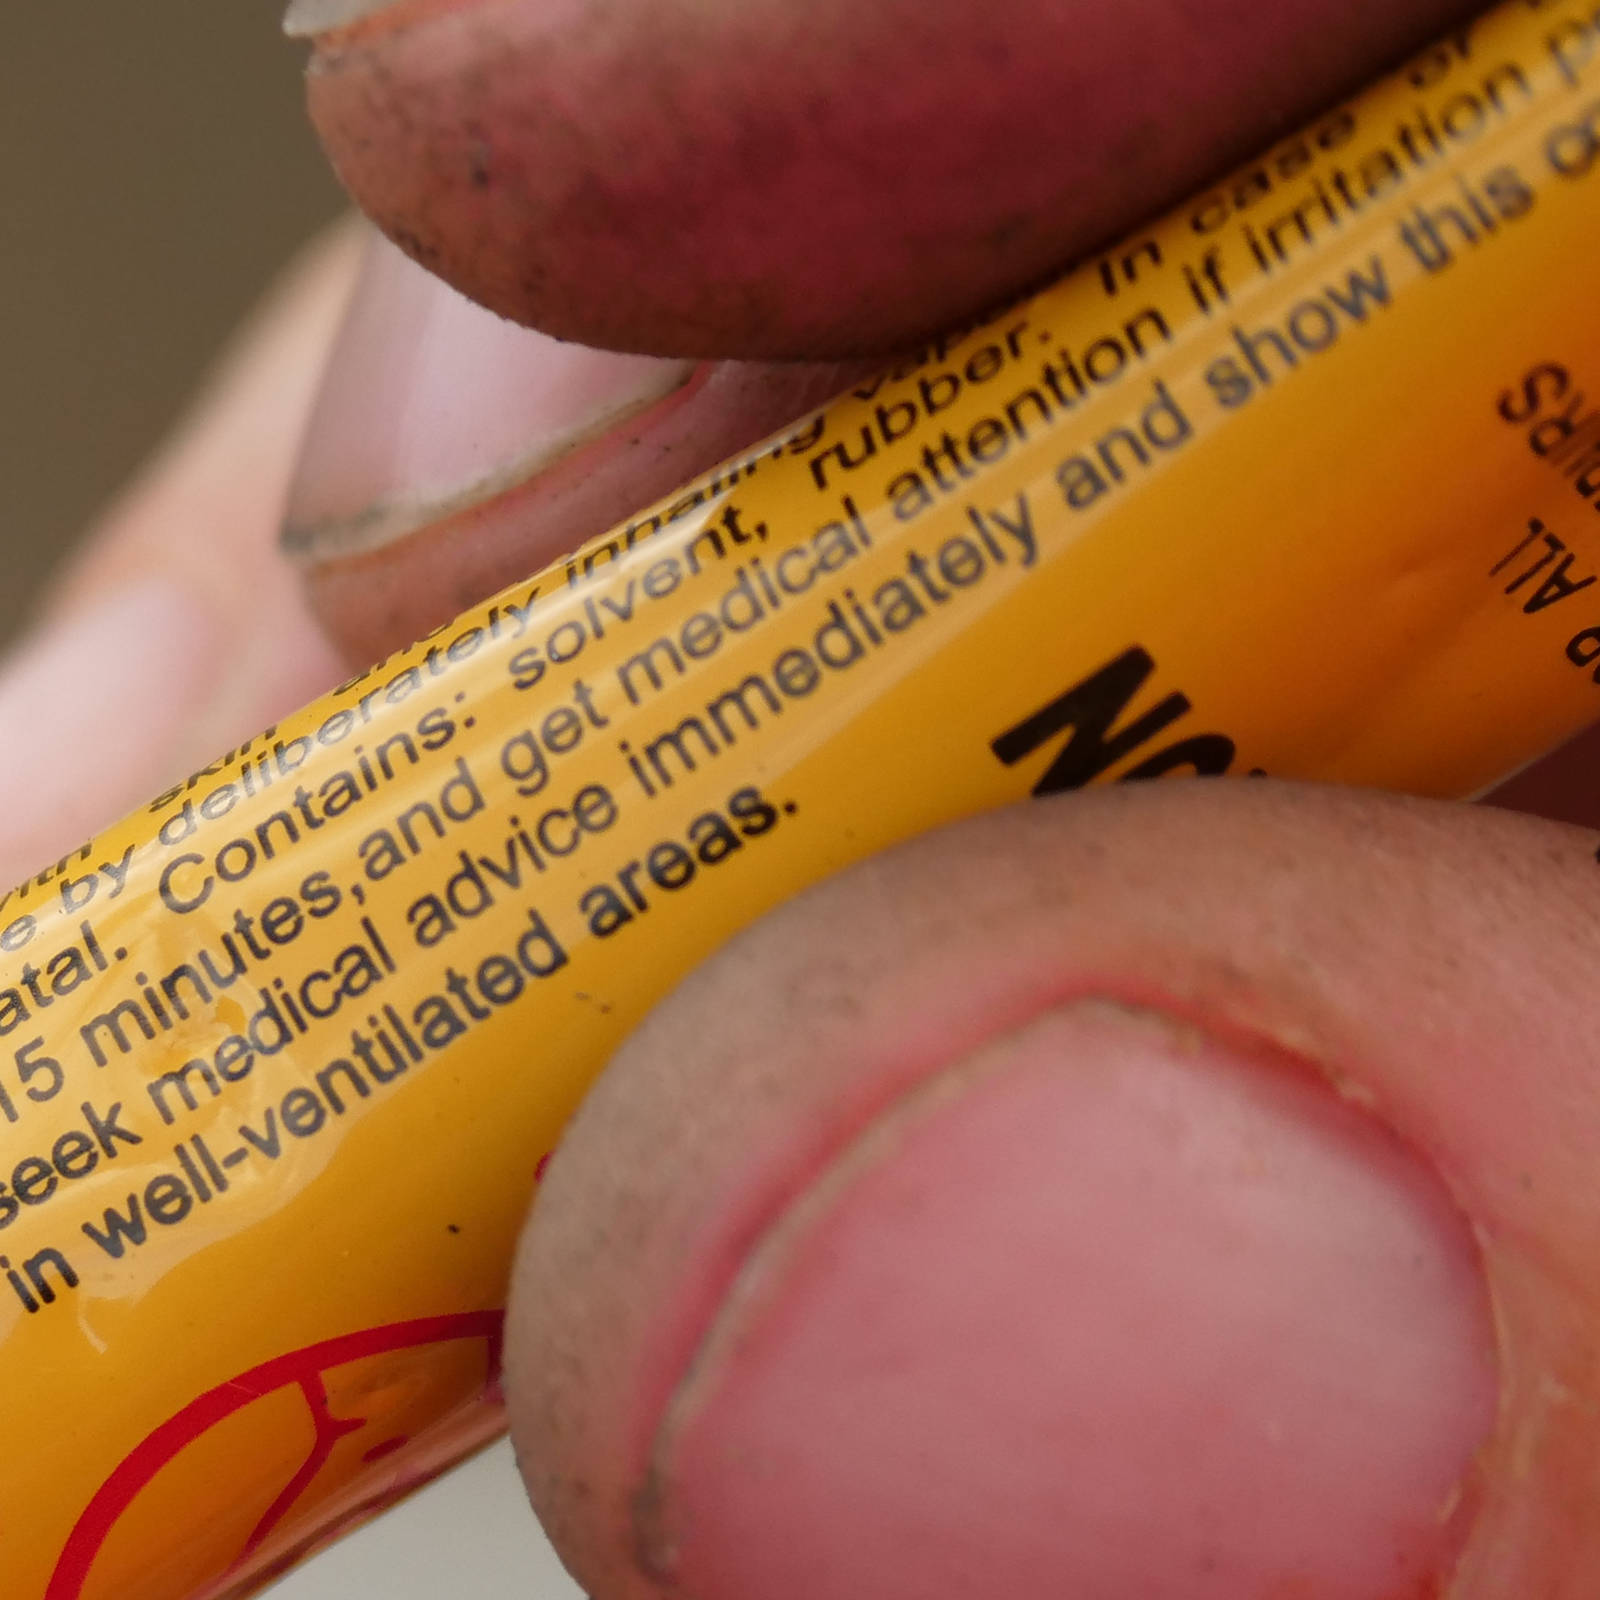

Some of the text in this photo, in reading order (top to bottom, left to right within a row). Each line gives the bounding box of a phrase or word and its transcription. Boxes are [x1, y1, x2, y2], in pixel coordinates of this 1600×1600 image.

[58, 843, 136, 921] by
[159, 584, 541, 846] deliberately
[147, 917, 398, 1126] medical
[405, 781, 621, 950] advice
[618, 490, 1041, 798] immediately
[1055, 378, 1195, 511] and
[1205, 256, 1392, 409] show
[1399, 167, 1535, 274] this
[157, 693, 478, 916] Contains:
[508, 500, 771, 693] solvent,
[809, 316, 1054, 492] rubber.
[1100, 236, 1165, 298] In
[1190, 108, 1357, 235] case
[501, 683, 610, 799] get
[618, 497, 873, 708] medical
[887, 302, 1174, 523] attention
[1180, 243, 1232, 317] if
[1243, 57, 1533, 278] irritation
[5, 1239, 81, 1314] in
[81, 910, 569, 1249] well-ventilated
[576, 780, 800, 942] areas.
